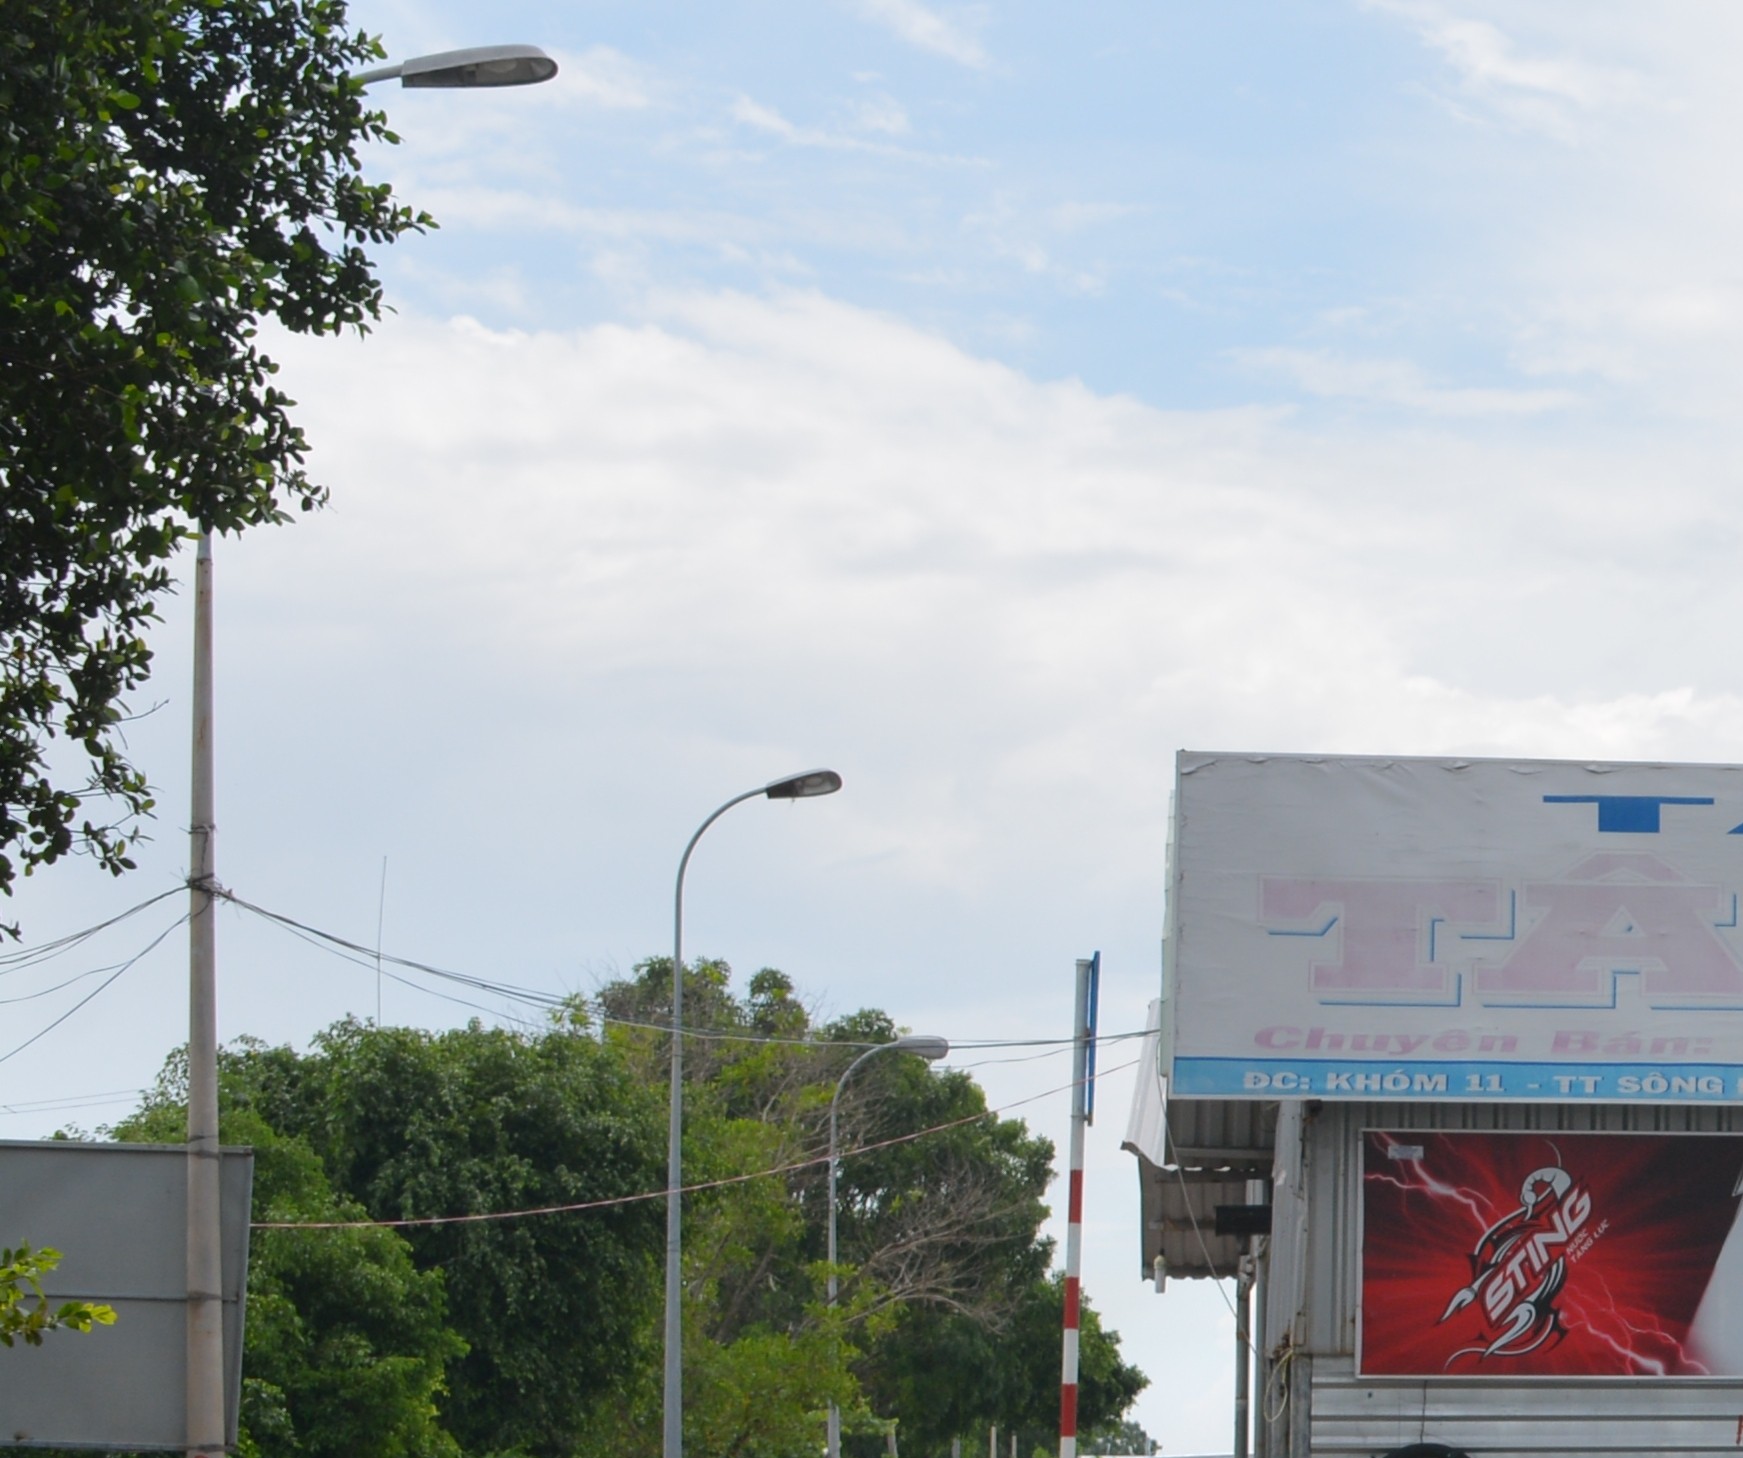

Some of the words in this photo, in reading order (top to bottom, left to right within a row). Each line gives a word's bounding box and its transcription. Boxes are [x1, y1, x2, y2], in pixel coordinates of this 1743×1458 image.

[1253, 1025, 1518, 1056] Chuyên
[1550, 1028, 1713, 1056] Bán:
[1243, 1071, 1310, 1091] ĐC:
[1326, 1068, 1449, 1092] KHÓM
[1465, 1074, 1503, 1092] 11
[1553, 1075, 1602, 1093] TT
[1616, 1071, 1725, 1095] SÔNG
[1486, 1187, 1591, 1321] STING
